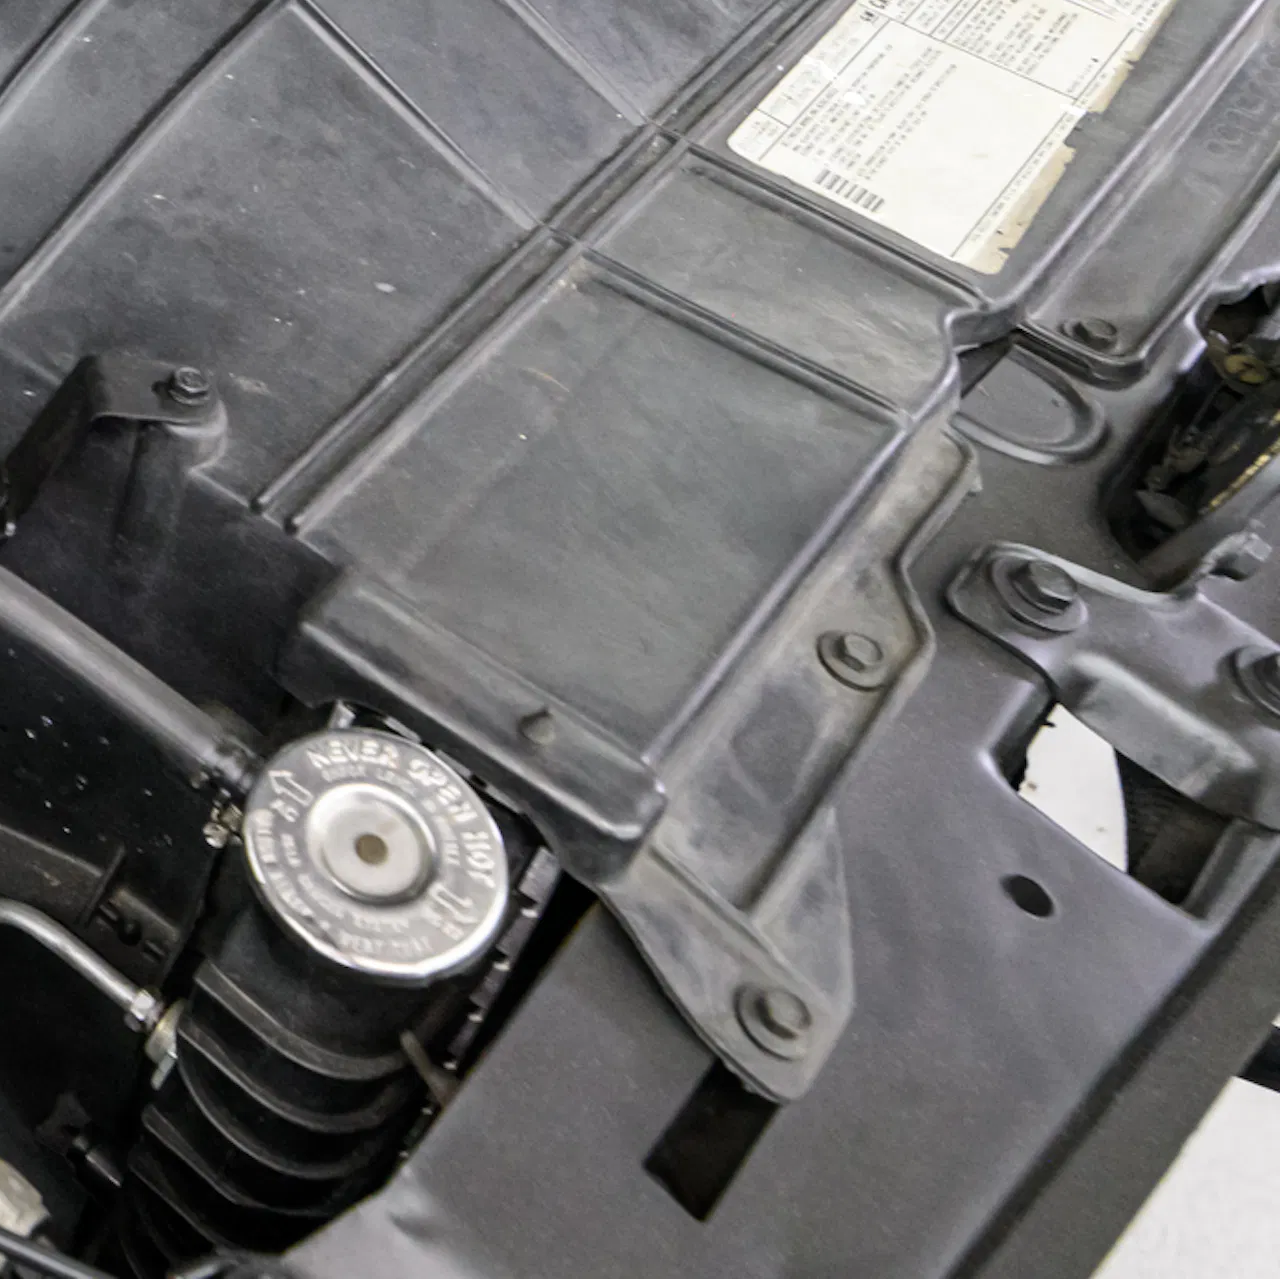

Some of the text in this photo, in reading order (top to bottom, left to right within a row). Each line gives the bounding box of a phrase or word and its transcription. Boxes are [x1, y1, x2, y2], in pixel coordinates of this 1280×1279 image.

[306, 739, 400, 770] NEVER
[409, 758, 478, 823] OPEN
[460, 831, 496, 888] HOT
